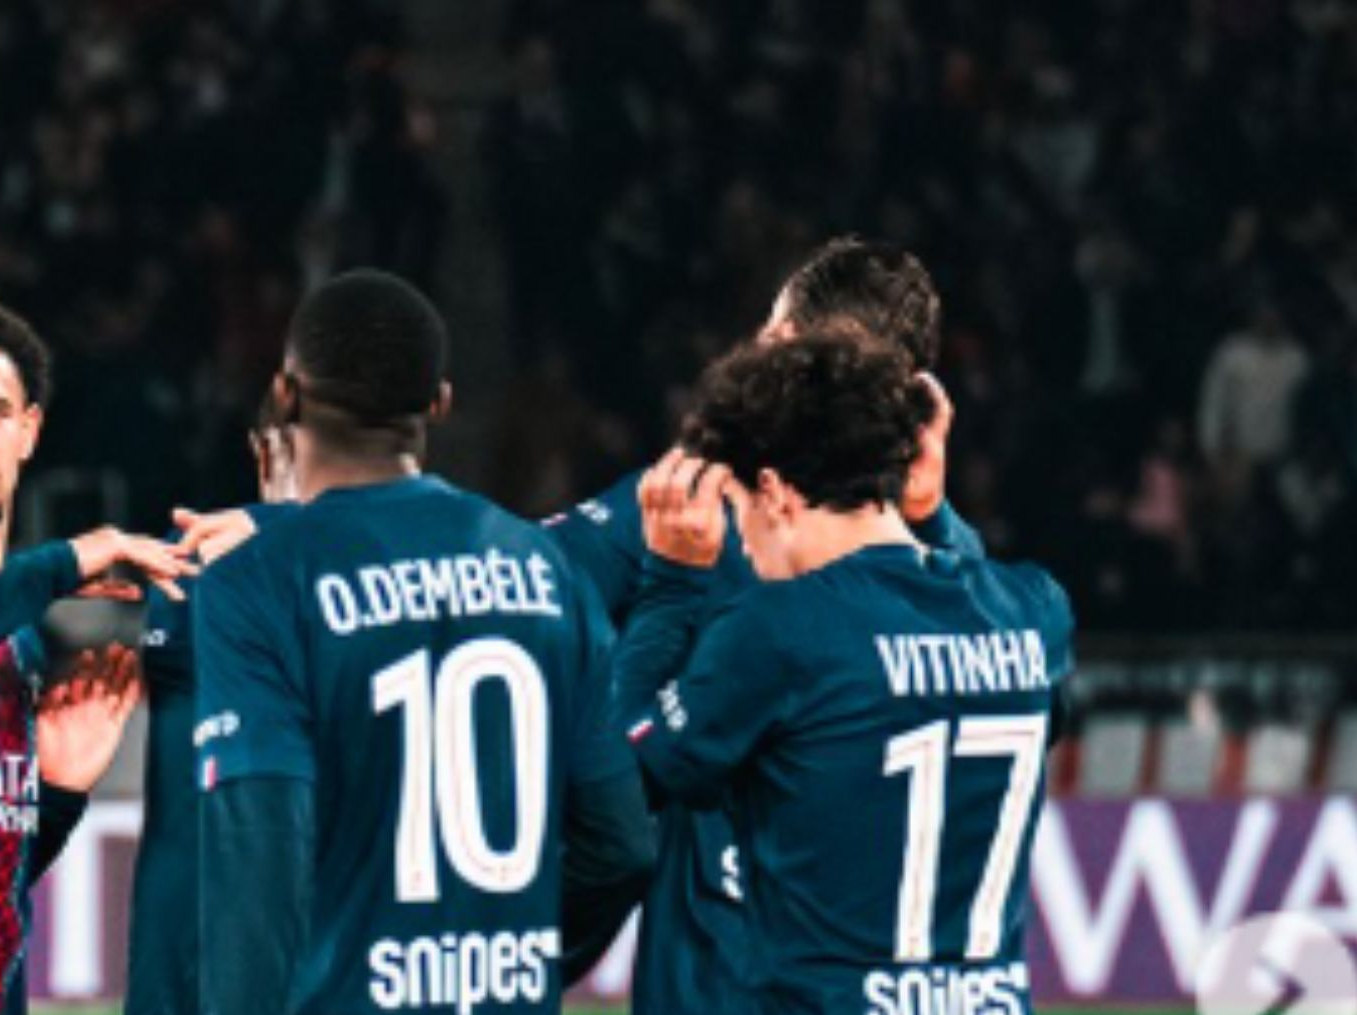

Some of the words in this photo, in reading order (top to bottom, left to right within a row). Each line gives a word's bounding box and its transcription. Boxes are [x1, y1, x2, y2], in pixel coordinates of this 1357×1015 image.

[371, 634, 550, 903] 10
[872, 627, 1052, 698] VITINHA
[882, 713, 1048, 962] 17
